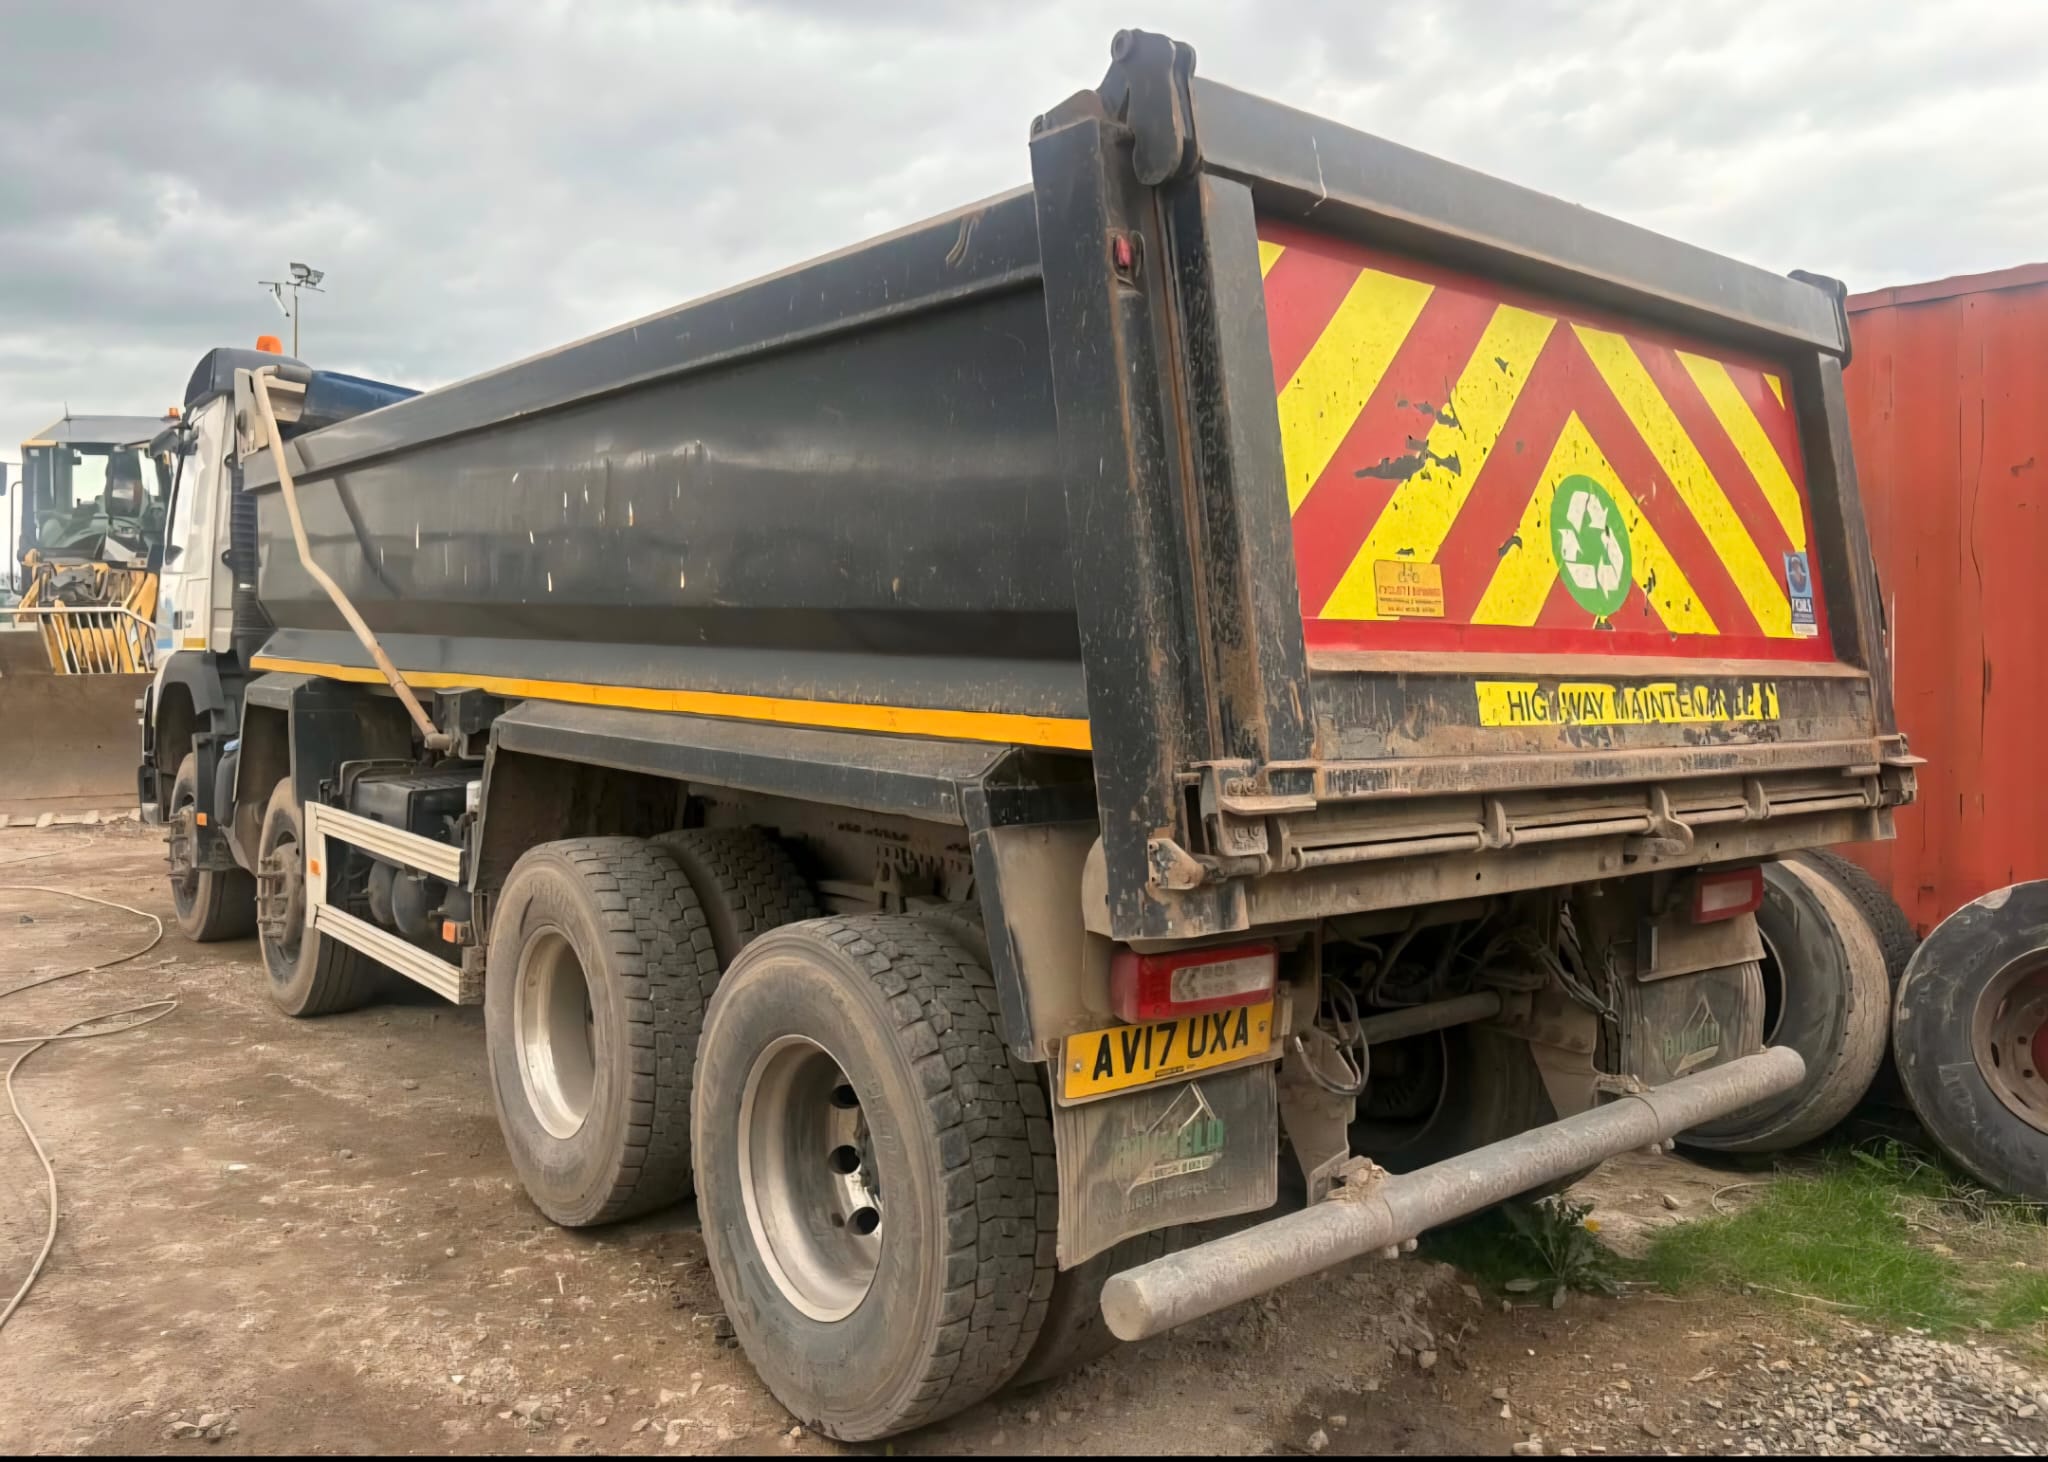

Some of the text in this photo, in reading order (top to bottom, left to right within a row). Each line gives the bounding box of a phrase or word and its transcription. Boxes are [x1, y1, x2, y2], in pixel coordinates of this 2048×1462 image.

[1506, 688, 1756, 721] HIGWAY MAINTENA
[1092, 1006, 1249, 1081] AV17 UXA
